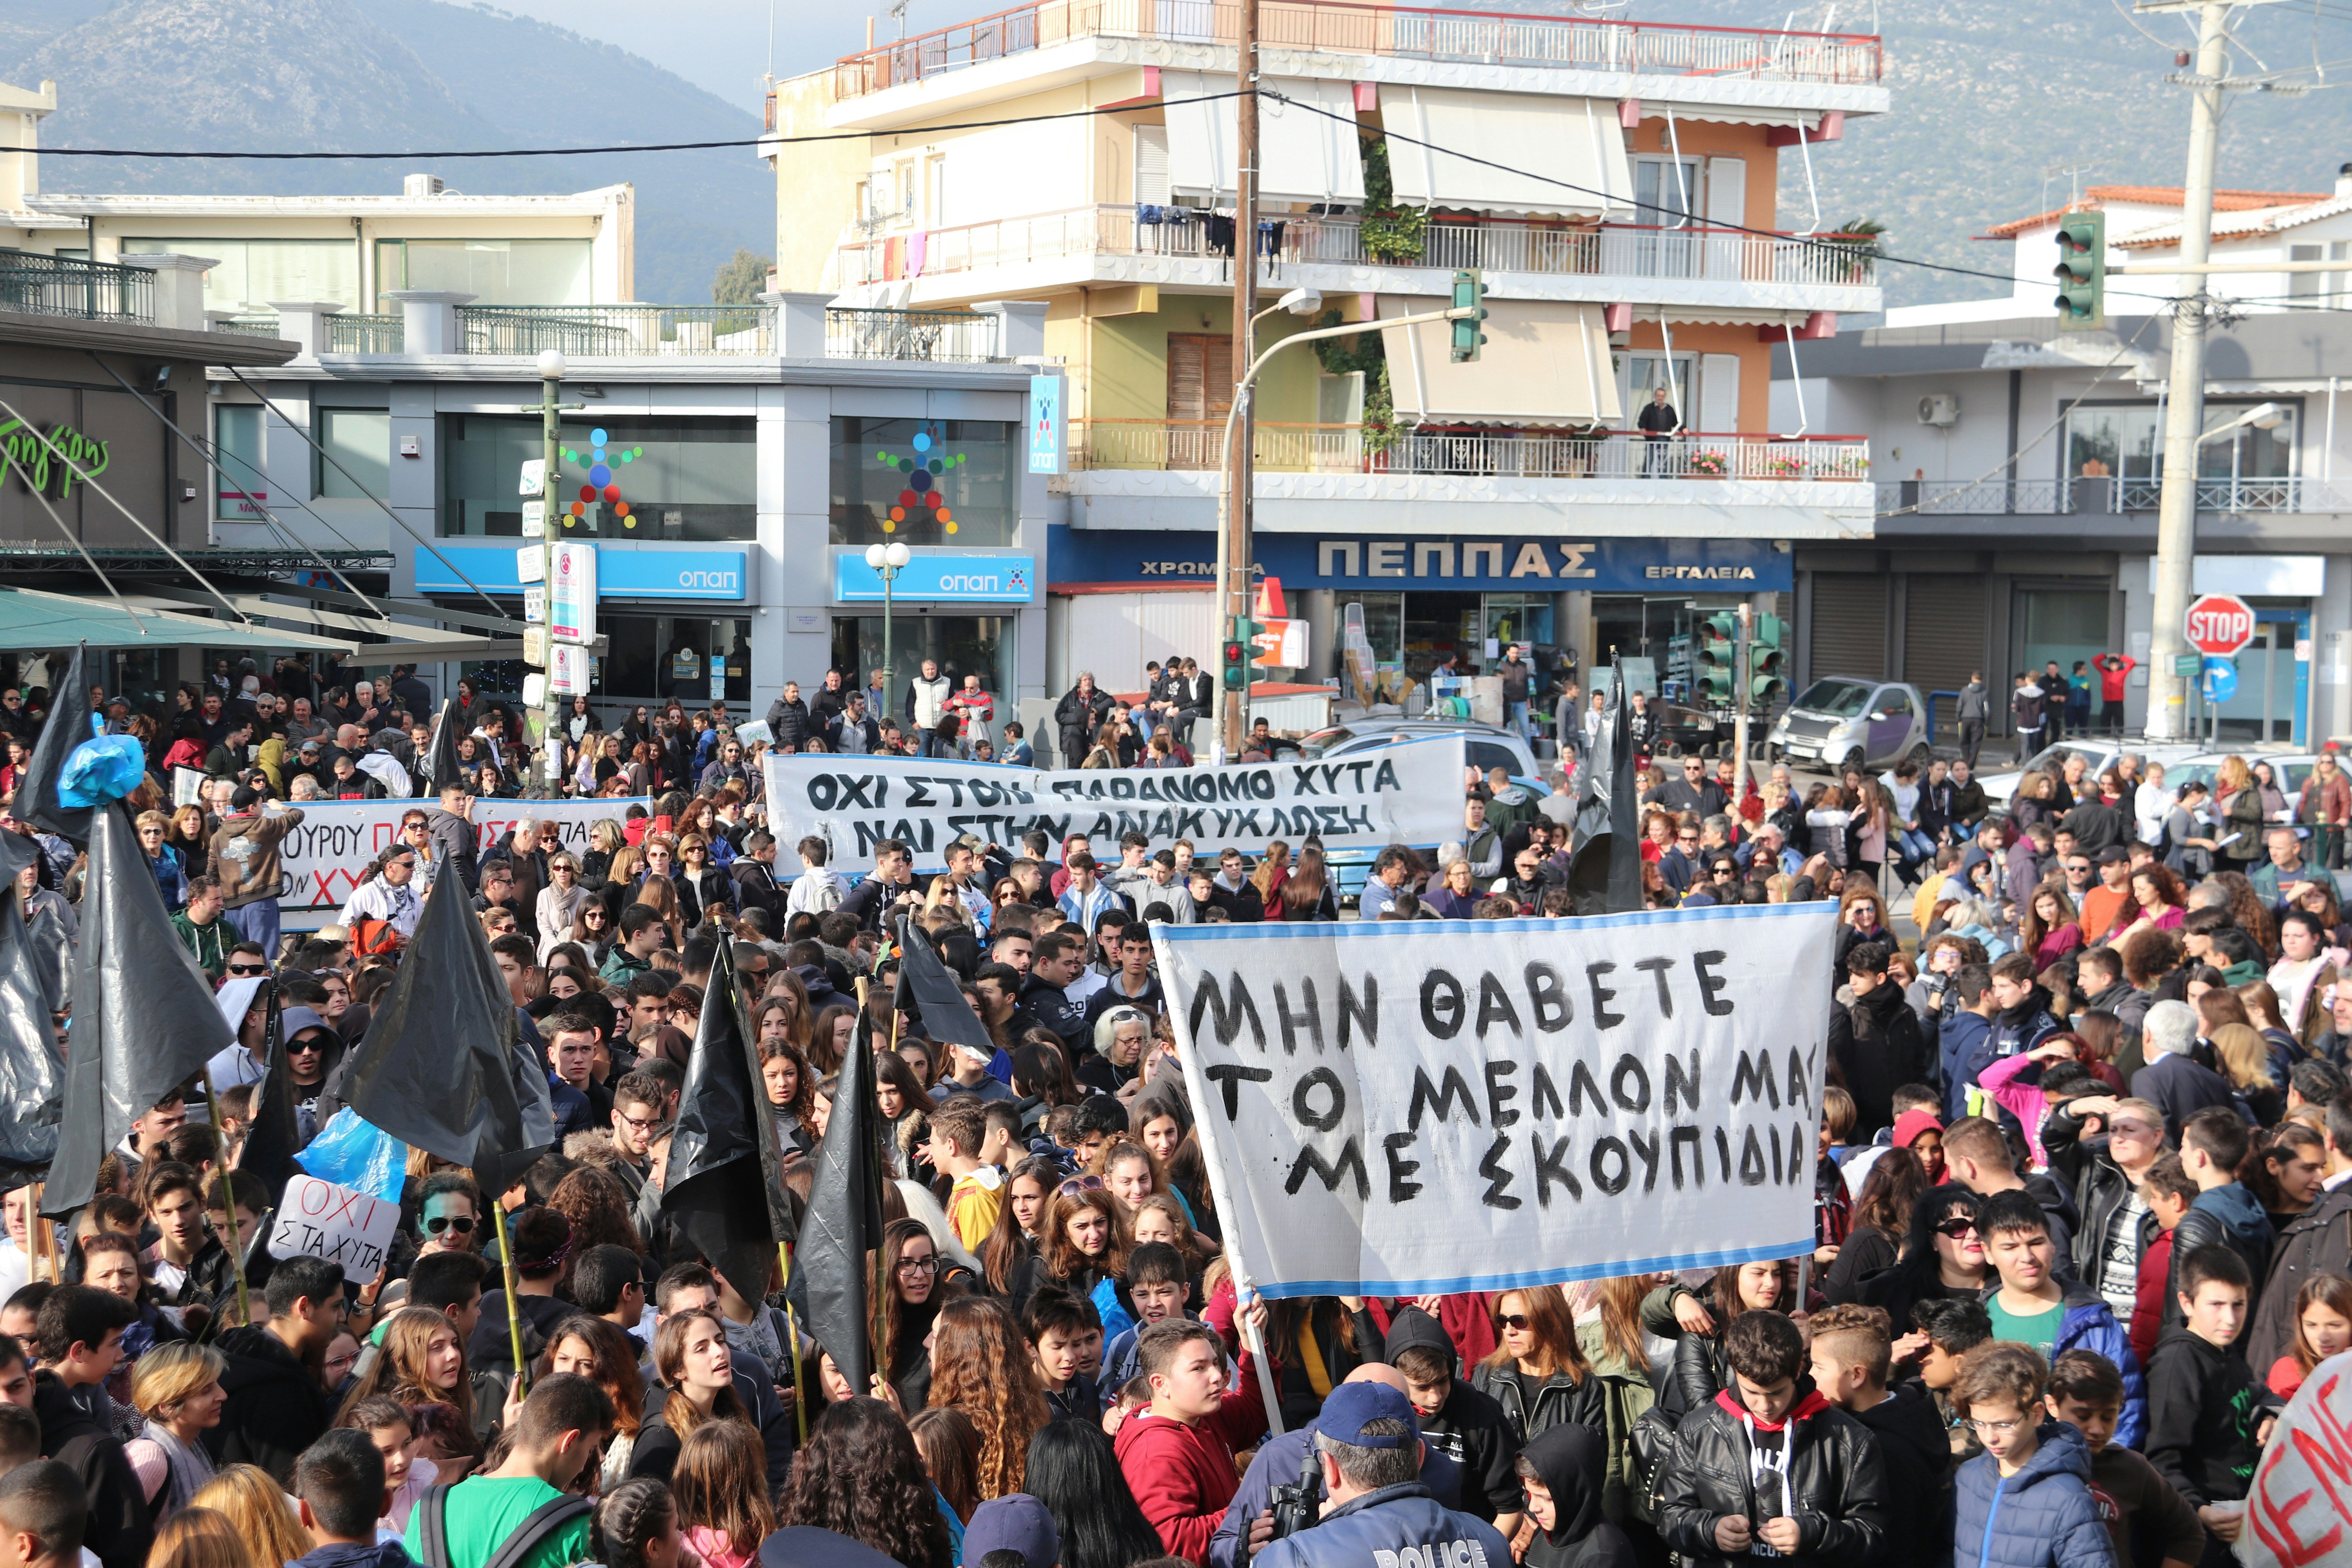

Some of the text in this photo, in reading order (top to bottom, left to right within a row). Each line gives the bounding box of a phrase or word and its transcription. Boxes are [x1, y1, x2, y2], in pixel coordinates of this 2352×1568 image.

[523, 553, 535, 565] PRESTO
[1141, 562, 1265, 575] ΧΡΩΜΑ
[1318, 541, 1596, 578] ΠΕΠΠΑΣ
[1645, 565, 1756, 580] ΕΡΓΑΛΕΙΑ
[553, 572, 578, 589] Beauty Nail
[2190, 611, 2247, 642] STOP
[807, 759, 1402, 811] ΟΧΙ ΣΤΟΝ ΠΑΡΑΝΟΜΟ ΧΥΤΑ
[853, 804, 1376, 859] ΝΑΙ ΣΤΗΝ ΑΝΑΚΥΚΛΩΣΗ
[1189, 969, 1378, 1056] ΜΗΝ
[1205, 1063, 1346, 1132] ΤΟ
[1408, 1047, 1701, 1132] ΜΕΛΛΟΝ
[1284, 1121, 1804, 1210] ΜΕ ΣΚΟΥΠΙΔΙΑ
[301, 1180, 376, 1232] ΟΧΙ
[1373, 1539, 1489, 1568] POLICE
